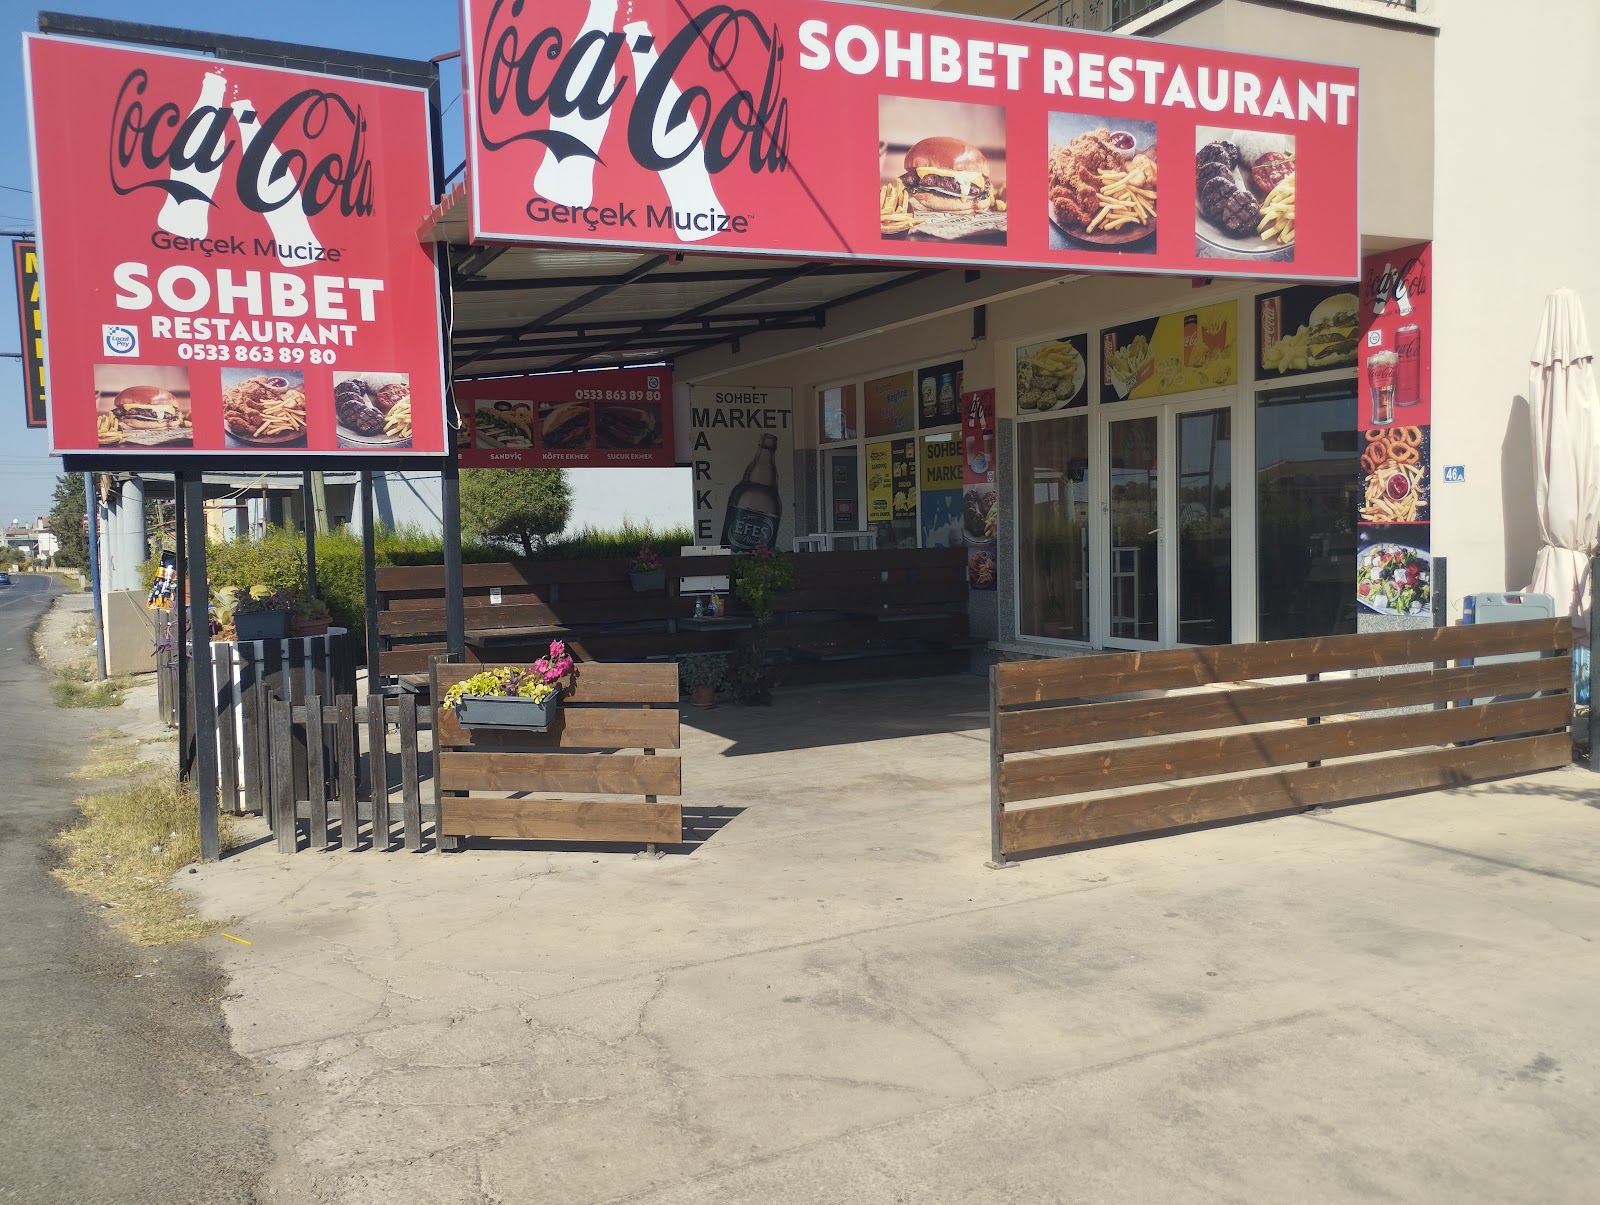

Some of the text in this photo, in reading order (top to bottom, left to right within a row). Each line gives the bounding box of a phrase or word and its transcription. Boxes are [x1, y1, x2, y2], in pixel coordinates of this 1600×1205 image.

[798, 19, 1356, 126] SOHBET RESTAURANT
[478, 0, 790, 175] Coca-Cola
[110, 68, 375, 218] Coca-Cola
[526, 197, 749, 234] Gerçek Mucize
[151, 230, 341, 262] Gerçek Mucize
[113, 261, 384, 322] SOHBET
[151, 315, 357, 346] RESTAURANT
[177, 343, 337, 365] 0533 863 89 80
[574, 389, 661, 401] 0533 863 89 80
[715, 392, 768, 404] SOHBET
[692, 407, 791, 429] MARKET
[542, 451, 565, 460] KÖFTE
[927, 441, 963, 459] SOHBE
[927, 465, 963, 482] MARKE
[734, 519, 768, 541] EFES
